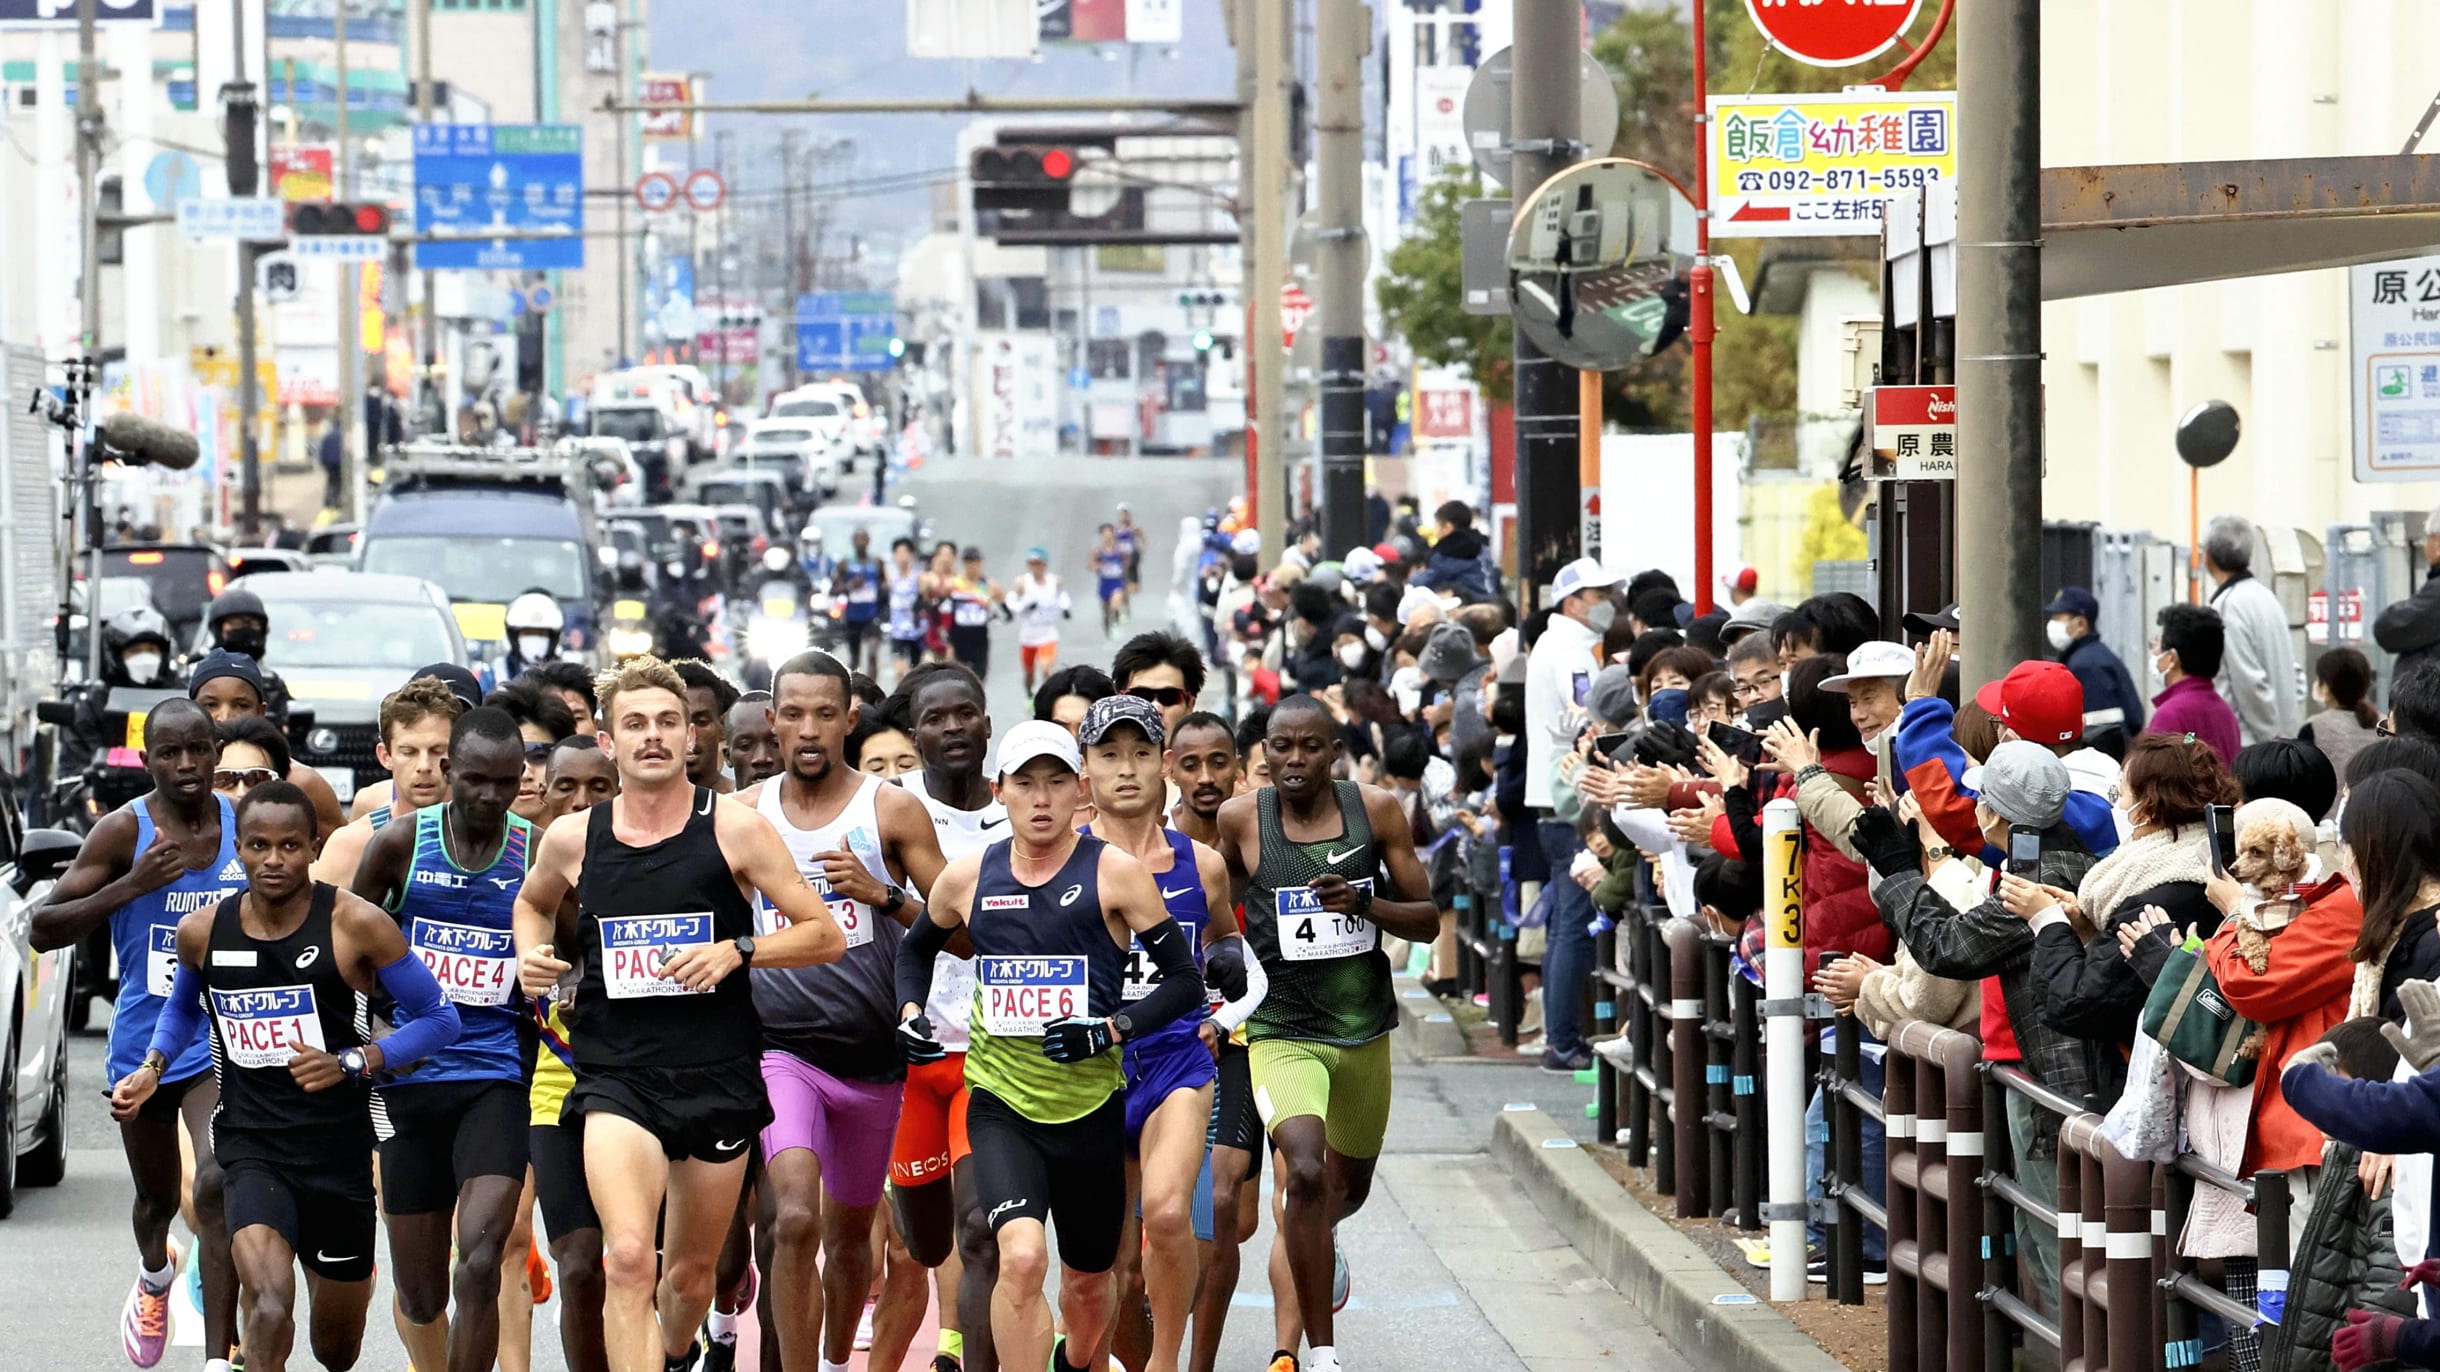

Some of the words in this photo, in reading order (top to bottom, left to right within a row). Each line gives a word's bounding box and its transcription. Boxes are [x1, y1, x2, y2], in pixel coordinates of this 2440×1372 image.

[1726, 109, 1945, 159] 飯倉幼稚園
[1769, 168, 1939, 190] 092-871-5593
[1796, 199, 1894, 221] ここ左折5
[1920, 461, 1953, 472] HARA
[934, 818, 948, 826] NN
[219, 871, 247, 881] adidas
[416, 870, 469, 889] 中電工
[984, 897, 1026, 909] Yakult
[841, 901, 858, 930] 3
[437, 927, 512, 951] 木下グループ
[624, 918, 700, 939] 木下グループ
[1295, 917, 1317, 943] 4
[424, 950, 488, 988] PACE
[491, 960, 505, 988] 4
[615, 948, 676, 980] PAC
[999, 960, 1074, 979] 木下グループ
[227, 990, 301, 1013] 木下グループ
[992, 987, 1052, 1018] PACE
[1059, 987, 1074, 1017] 6
[226, 1020, 287, 1051] PACE
[291, 1017, 304, 1045] 1
[893, 1151, 949, 1178] INEOS
